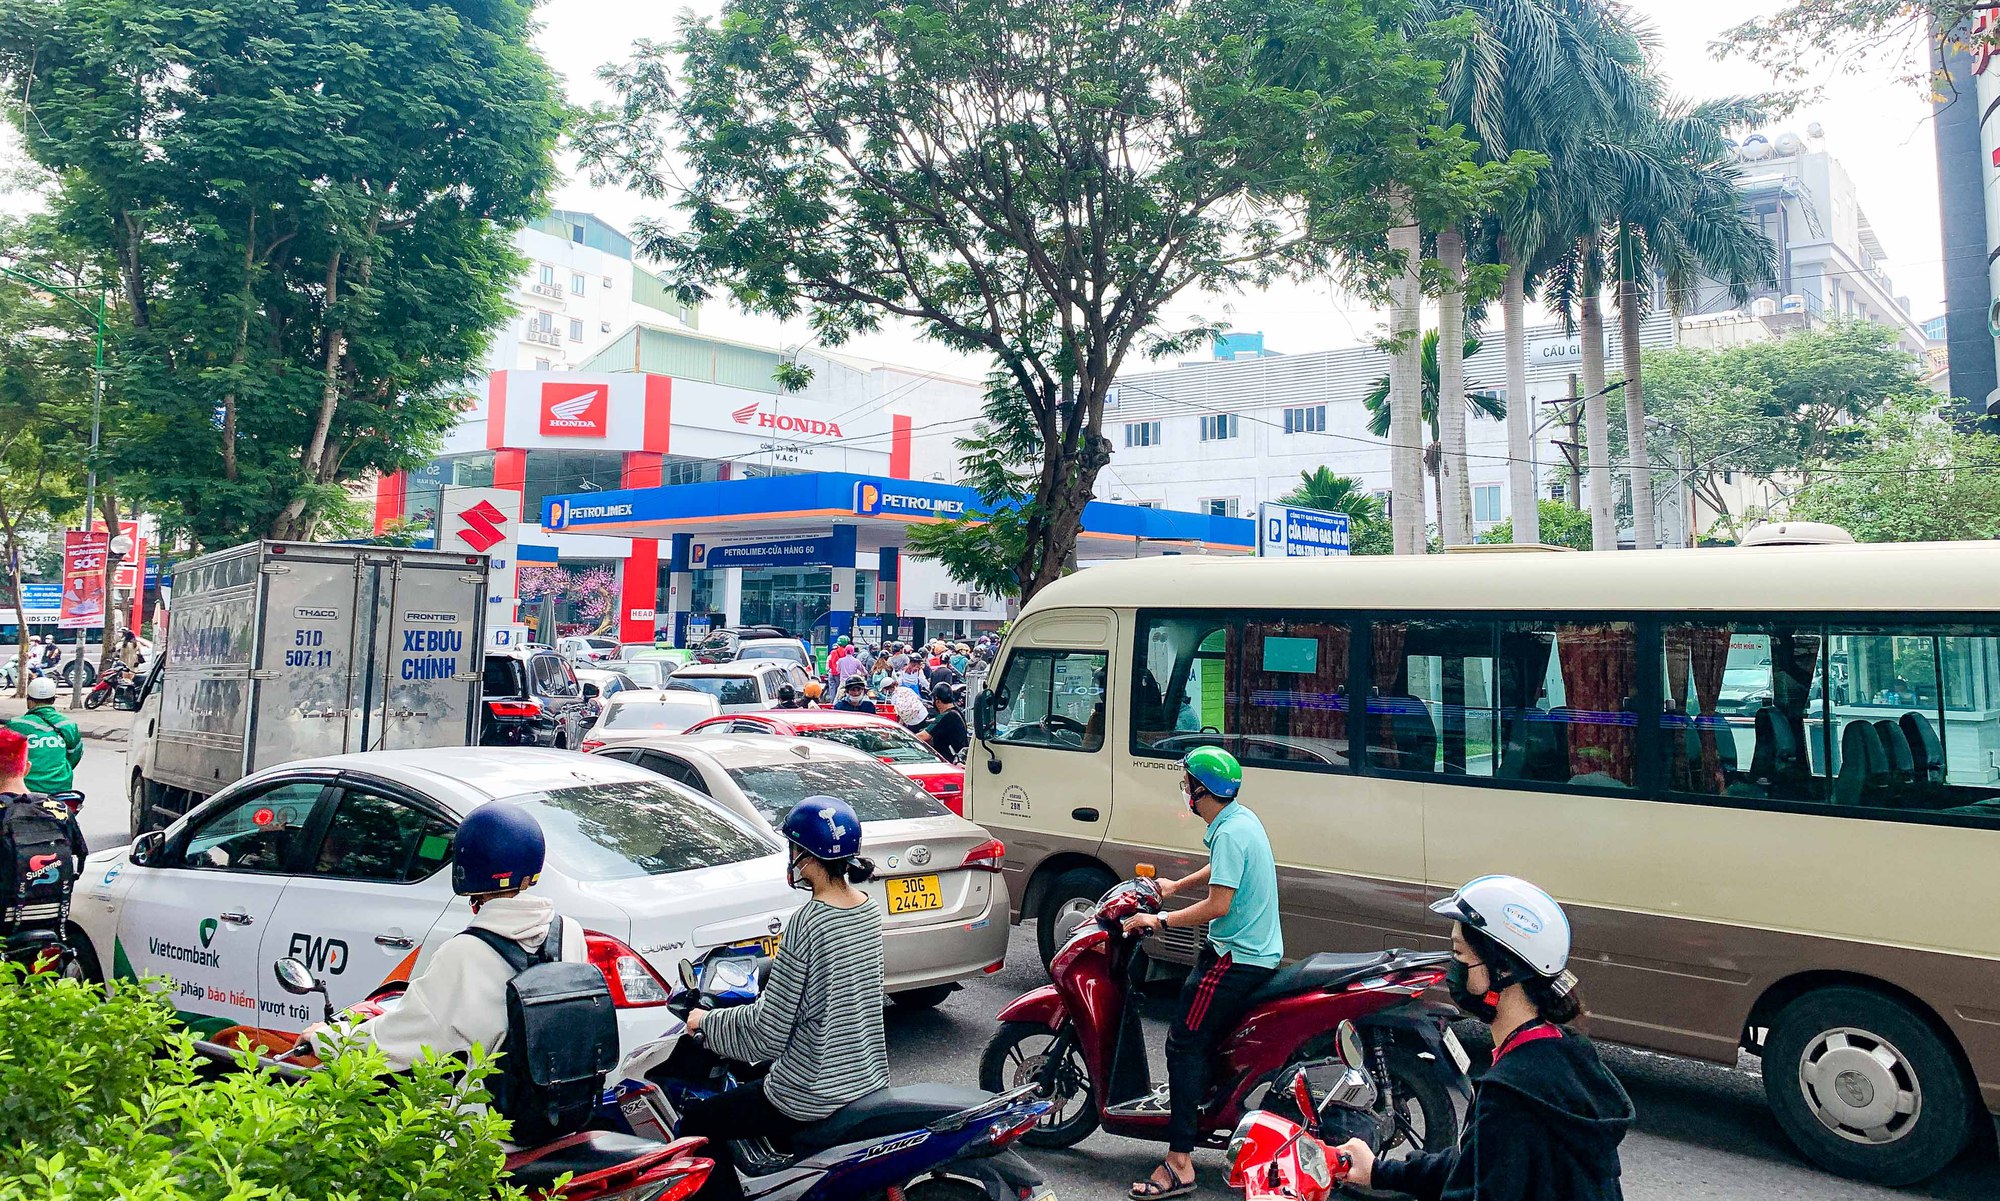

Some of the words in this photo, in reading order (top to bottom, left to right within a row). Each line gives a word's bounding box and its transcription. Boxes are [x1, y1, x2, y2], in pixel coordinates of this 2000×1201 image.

[1569, 345, 1582, 355] GI
[549, 419, 598, 428] HONDA
[758, 412, 843, 438] HONDA
[570, 504, 633, 518] PETROLIMEX
[882, 494, 965, 513] PETROLIMEX
[1302, 523, 1319, 543] HÀNG
[1320, 528, 1332, 544] GAS
[784, 543, 804, 555] HÀNG
[805, 545, 815, 554] 60
[74, 555, 100, 569] SỐC
[298, 609, 336, 618] THACO
[406, 613, 456, 621] FRONTIER
[295, 630, 323, 647] 51D
[403, 630, 425, 652] XE
[426, 629, 462, 652] BƯU
[285, 650, 332, 667] 507.11
[401, 654, 456, 680] CHÍNH
[1132, 761, 1166, 770] HYUNDAI
[26, 859, 62, 880] Supreme
[902, 878, 925, 894] 30G
[895, 893, 937, 911] 244.72
[149, 936, 221, 968] Vietcombank
[288, 932, 349, 975] FWD
[641, 940, 686, 954] SUNNY
[181, 980, 204, 1000] pháp
[207, 986, 226, 1003] bảo
[229, 989, 255, 1009] hiểm
[259, 999, 286, 1016] vượt
[289, 1004, 310, 1023] trội
